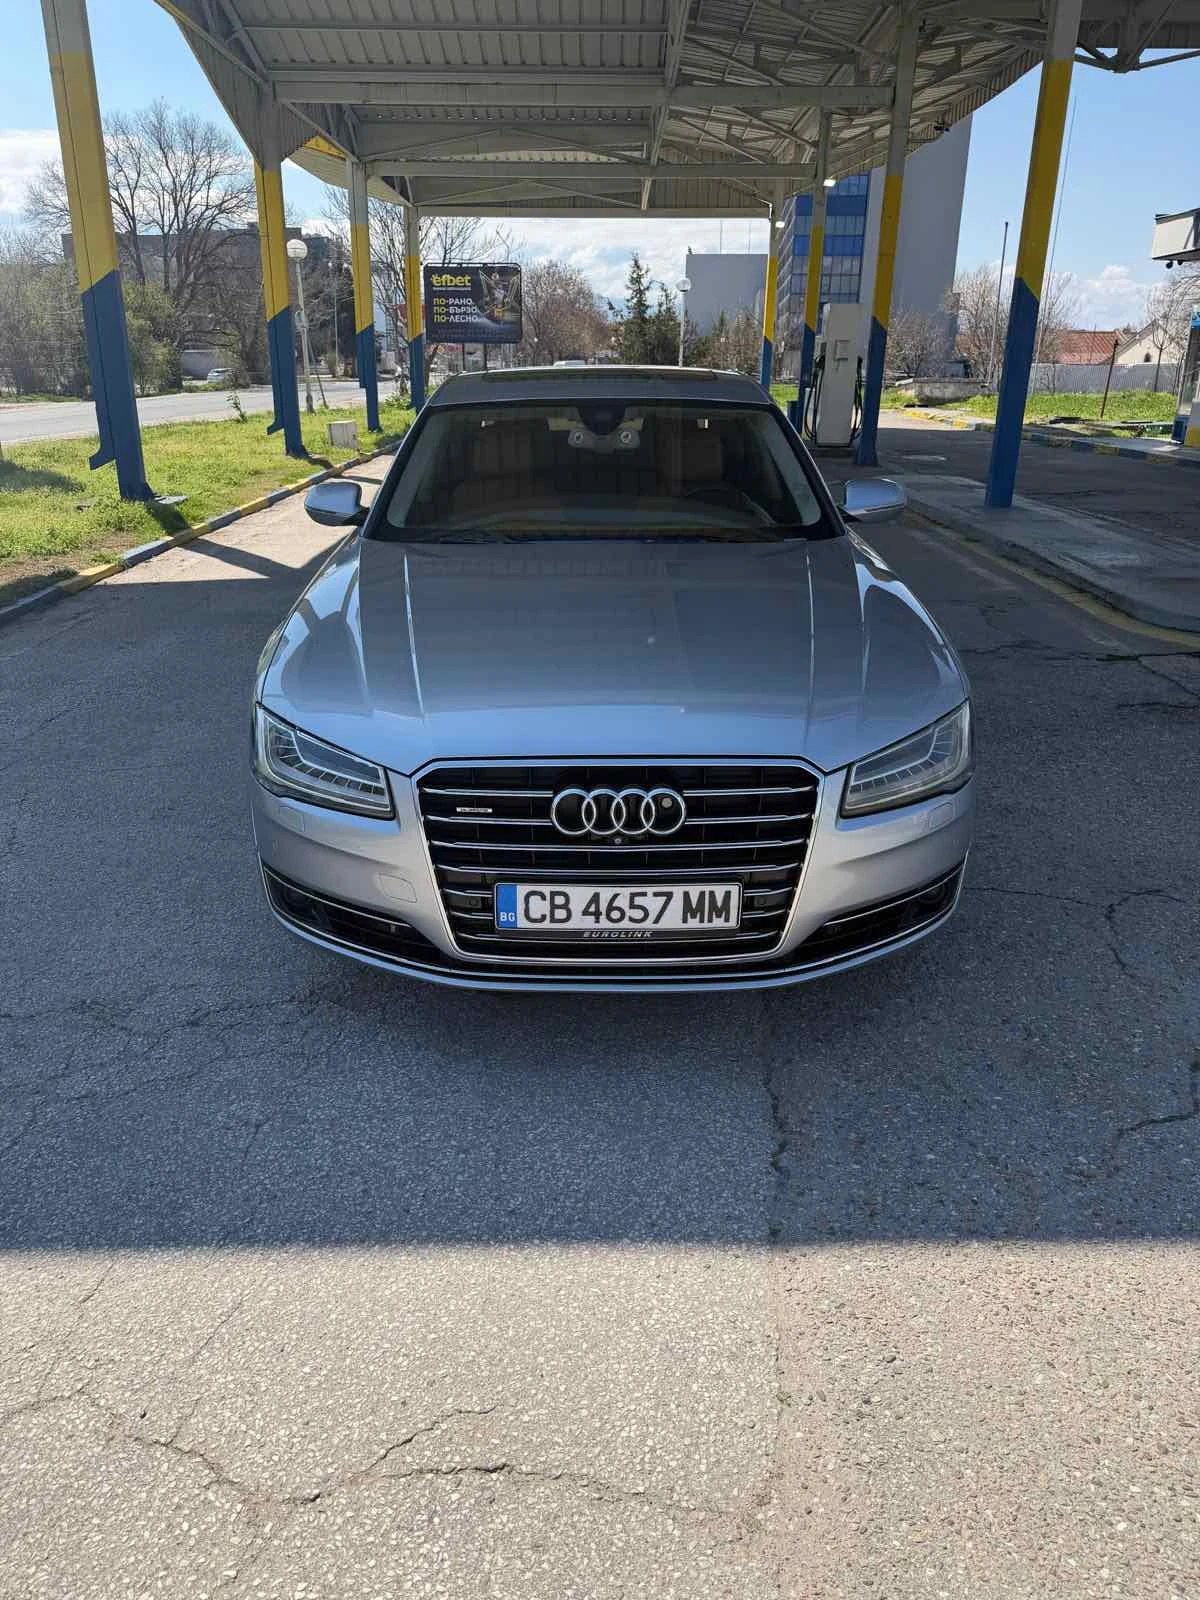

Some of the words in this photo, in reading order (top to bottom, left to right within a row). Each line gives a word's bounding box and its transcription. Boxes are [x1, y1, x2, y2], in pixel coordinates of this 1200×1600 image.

[431, 273, 471, 286] efbet
[523, 890, 572, 924] CB
[581, 891, 674, 924] 4657
[681, 890, 732, 924] MM
[500, 912, 516, 922] BG
